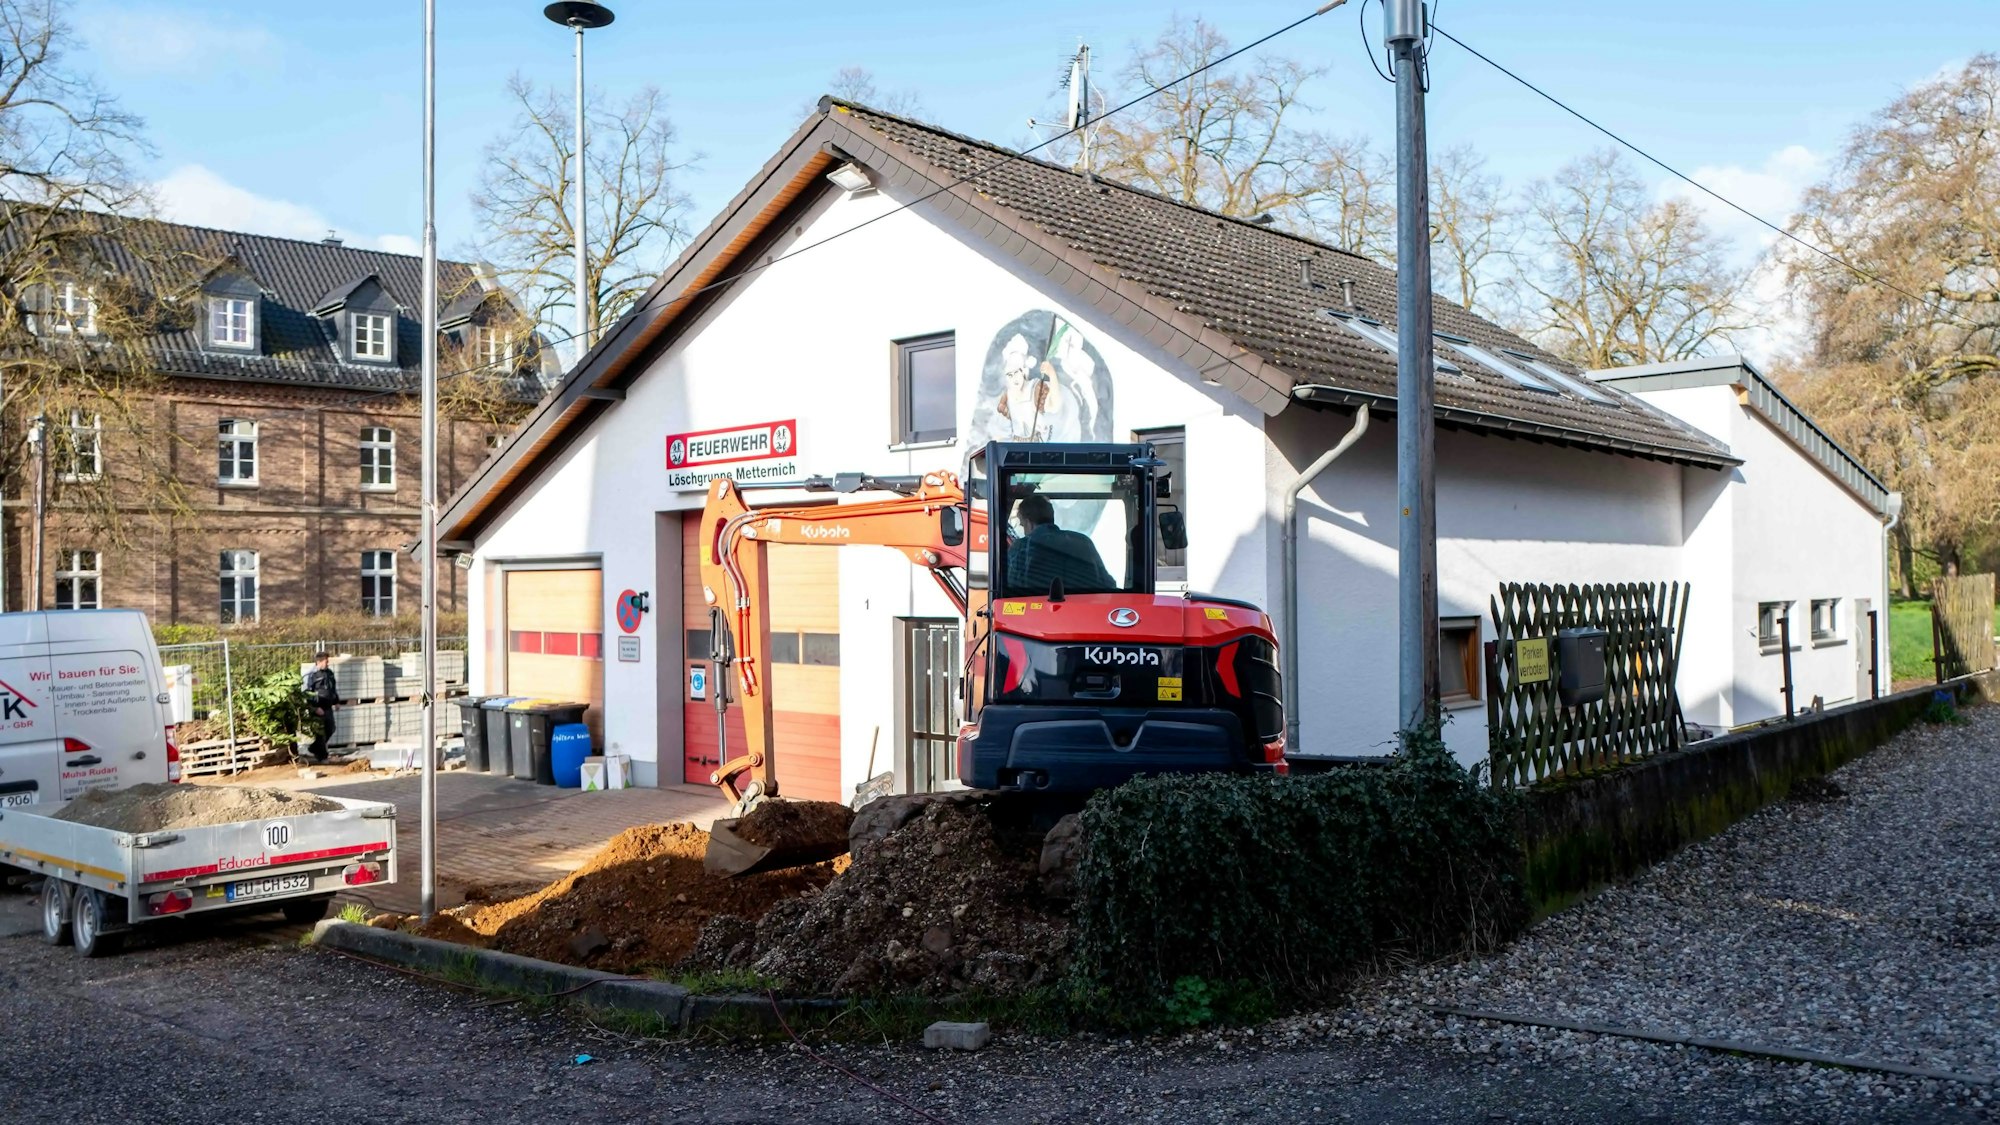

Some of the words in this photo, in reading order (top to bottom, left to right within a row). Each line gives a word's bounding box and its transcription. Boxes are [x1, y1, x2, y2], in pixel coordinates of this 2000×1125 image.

[689, 433, 768, 458] FEUERWEHR
[736, 461, 796, 480] Metternich
[801, 524, 850, 538] Kubota
[1084, 646, 1159, 665] Kubota
[1522, 646, 1543, 660] Parken
[29, 671, 52, 681] Wir
[58, 668, 96, 679] bauen
[99, 666, 115, 676] für
[118, 665, 140, 675] Sie:
[79, 682, 93, 690] und
[95, 679, 146, 689] Betonarbeiten
[56, 692, 85, 700] Umbau
[64, 700, 89, 708] Innen-
[91, 698, 106, 706] und
[107, 695, 146, 705] Außenputz
[72, 706, 117, 716] Trockenbau
[13, 720, 34, 729] GbR
[63, 771, 86, 779] Muha
[89, 767, 117, 776] Rudari
[7, 794, 30, 807] 906
[266, 825, 288, 846] 100
[218, 852, 268, 870] Eduard
[235, 882, 253, 896] EU
[262, 878, 280, 892] CH
[283, 874, 307, 889] 532
